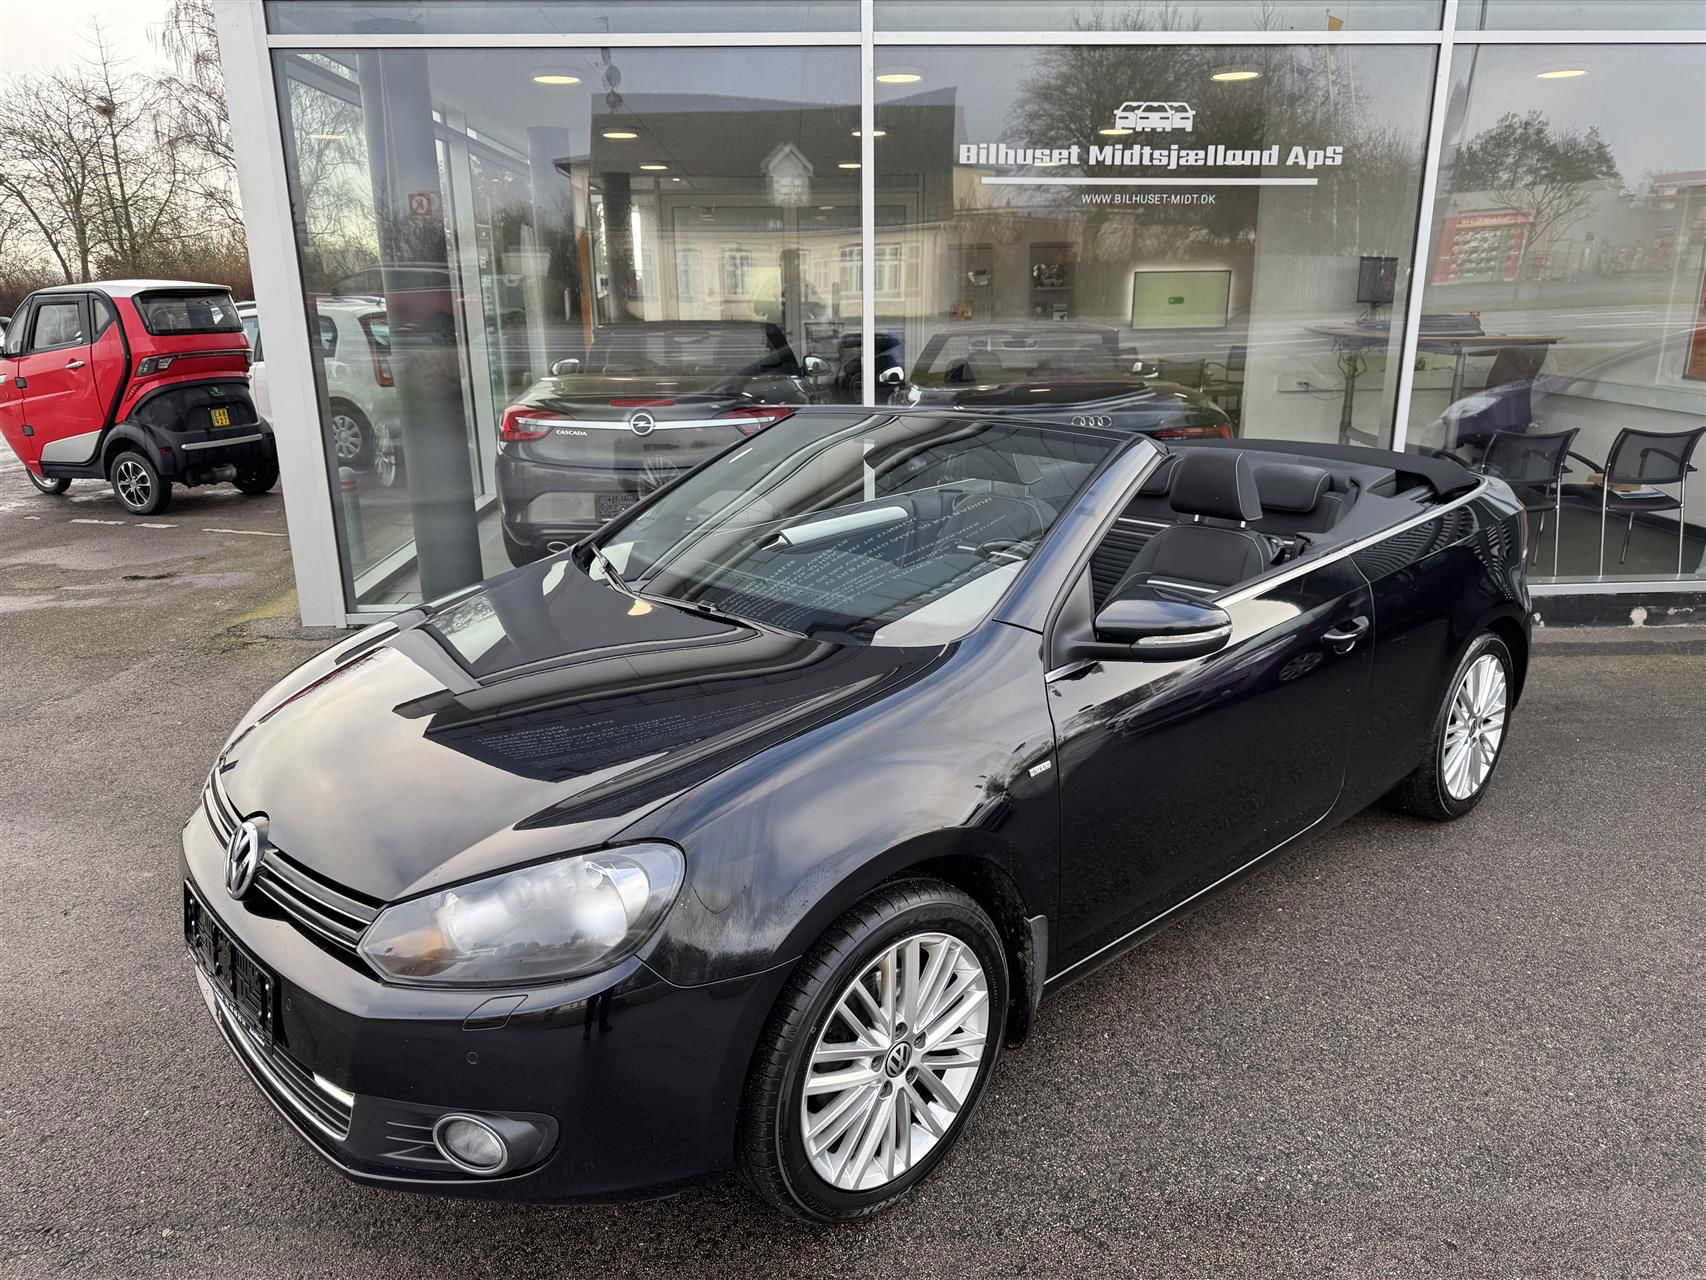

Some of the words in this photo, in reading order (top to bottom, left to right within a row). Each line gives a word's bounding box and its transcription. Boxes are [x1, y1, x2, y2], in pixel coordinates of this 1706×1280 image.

[959, 143, 1081, 166] Bilhuset
[1088, 144, 1279, 170] Midtsjælland
[1285, 145, 1344, 170] ApS
[1081, 193, 1216, 205] WWW.BILHUSET-MIDT.DK
